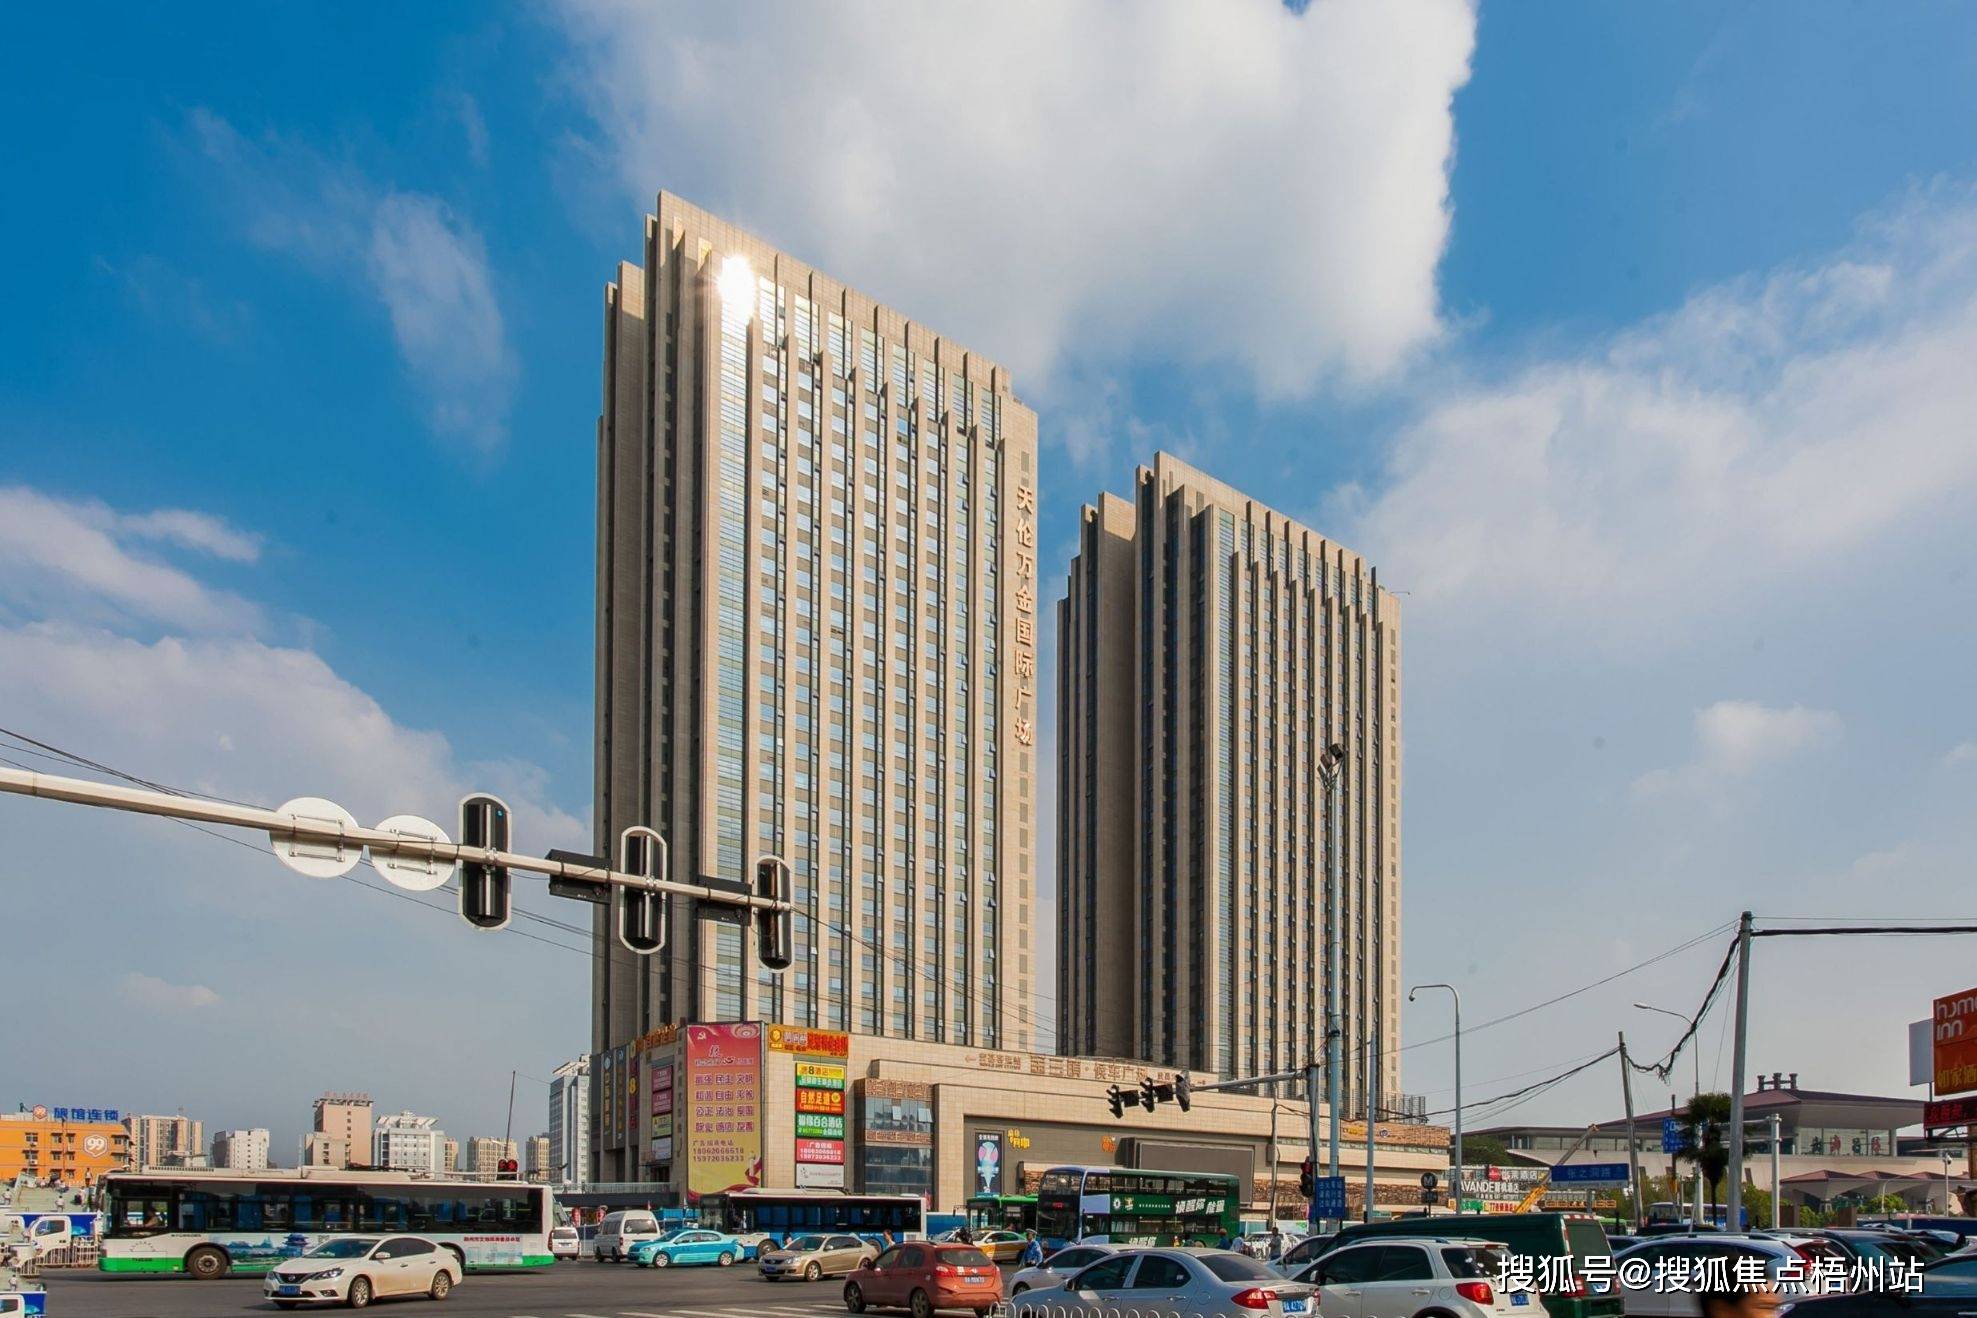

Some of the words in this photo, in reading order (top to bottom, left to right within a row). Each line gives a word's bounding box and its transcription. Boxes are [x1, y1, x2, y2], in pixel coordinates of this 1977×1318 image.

[1015, 486, 1033, 746] 天伦万金国际广场
[1936, 996, 1977, 1021] hom
[54, 1107, 119, 1120] 旅馆连锁
[87, 1138, 105, 1151] 99
